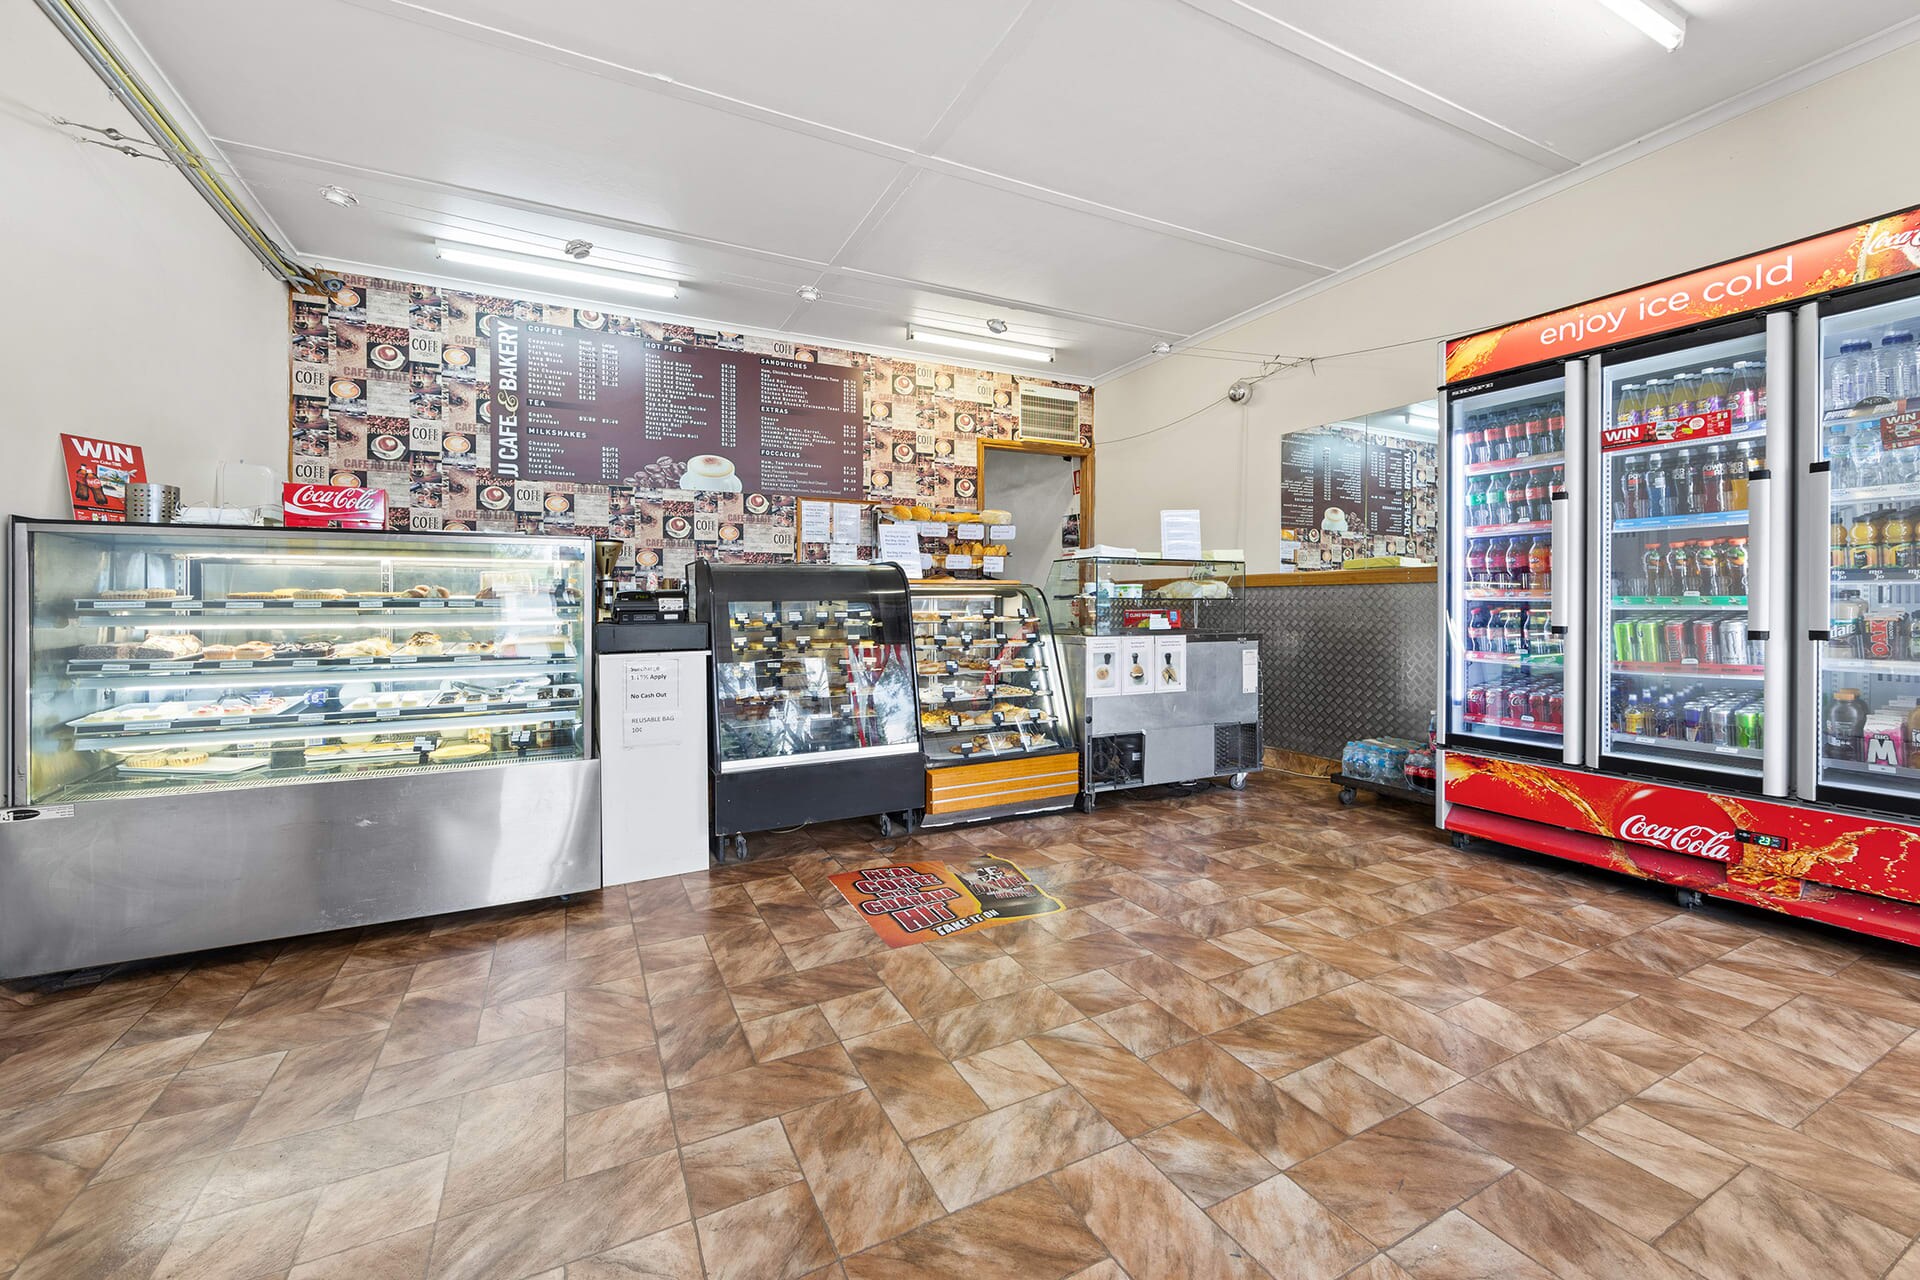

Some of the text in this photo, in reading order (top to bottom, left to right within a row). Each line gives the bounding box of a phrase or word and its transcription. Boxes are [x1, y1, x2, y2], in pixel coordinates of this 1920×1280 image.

[1540, 256, 1793, 344] enjoy ice cold
[528, 325, 563, 336] COFFEE
[664, 344, 682, 353] PIES
[761, 359, 807, 369] SANDWICHES
[497, 321, 518, 478] JJ CAFE & BAKERY
[1886, 412, 1916, 424] WIN
[528, 428, 587, 438] MILKSHAKES
[1605, 428, 1639, 442] WIN
[70, 438, 134, 464] WIN
[761, 450, 800, 458] FOCCACIAS
[293, 485, 376, 510] Coca-Cola
[1871, 621, 1889, 657] OAK
[1868, 739, 1898, 765] M
[1620, 814, 1734, 859] Coca-Cola
[855, 875, 944, 894] COFFEE
[861, 867, 916, 881] REAL
[862, 888, 960, 914] GUARANA
[891, 902, 956, 932] HIT
[932, 909, 1000, 936] TAKE IT ON
